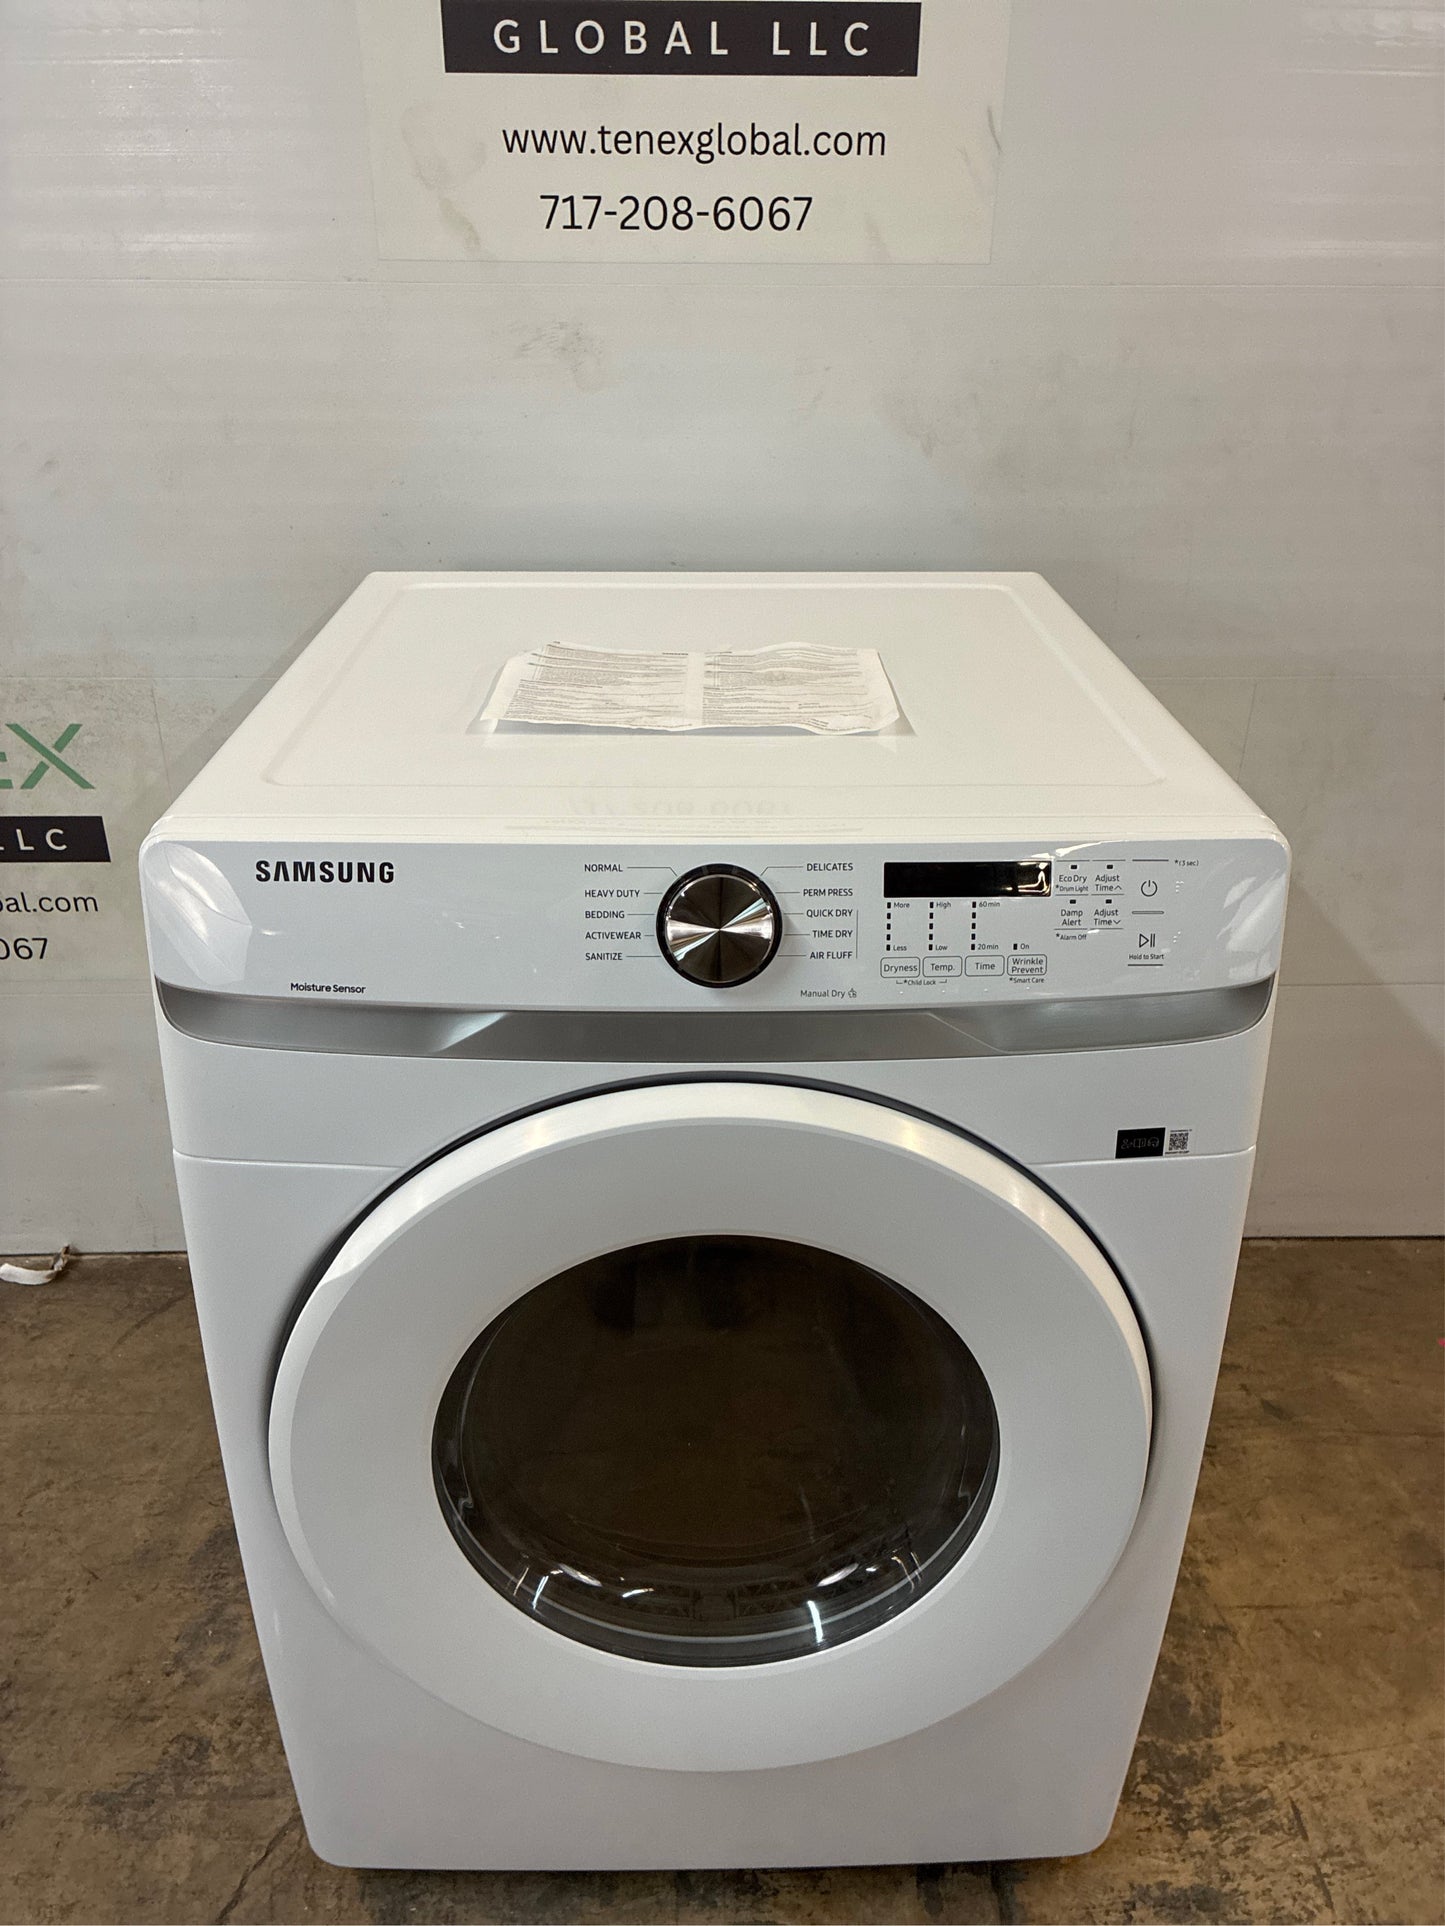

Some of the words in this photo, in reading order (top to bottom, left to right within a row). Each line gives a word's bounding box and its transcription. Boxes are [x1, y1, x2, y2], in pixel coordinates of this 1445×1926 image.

[493, 19, 729, 56] GLOBAL
[772, 22, 870, 56] LLC
[502, 123, 887, 164] www.tenexglobal.com
[540, 194, 814, 232] 717-208-6067
[0, 724, 95, 790] X
[0, 829, 67, 850] LC
[256, 860, 394, 883] SAMSUNG
[584, 864, 623, 872] NORMAL
[807, 863, 853, 871] DELICATES
[1073, 875, 1087, 883] Dry
[1095, 875, 1120, 883] Adjust
[585, 890, 614, 898] HEAVY
[803, 889, 826, 897] PERM
[828, 889, 853, 897] PRESS
[0, 892, 98, 912] al.com
[585, 911, 625, 919] BEDDING
[807, 910, 833, 919] QUICK
[836, 909, 853, 917] DRY
[1061, 909, 1083, 918] Damp
[1094, 909, 1119, 918] Adjust
[1062, 918, 1081, 926] Alert
[585, 931, 641, 940] ACTIVEWEAR
[835, 930, 853, 938] DRY
[585, 953, 623, 961] SANITIZE
[826, 951, 852, 959] FLUFF
[884, 964, 918, 974] Dryness
[931, 963, 955, 973] Temp.
[975, 962, 995, 970] Time
[291, 983, 331, 992] Moisture
[333, 984, 366, 993] Sensor
[800, 990, 828, 998] Manual
[831, 990, 845, 999] Dry
